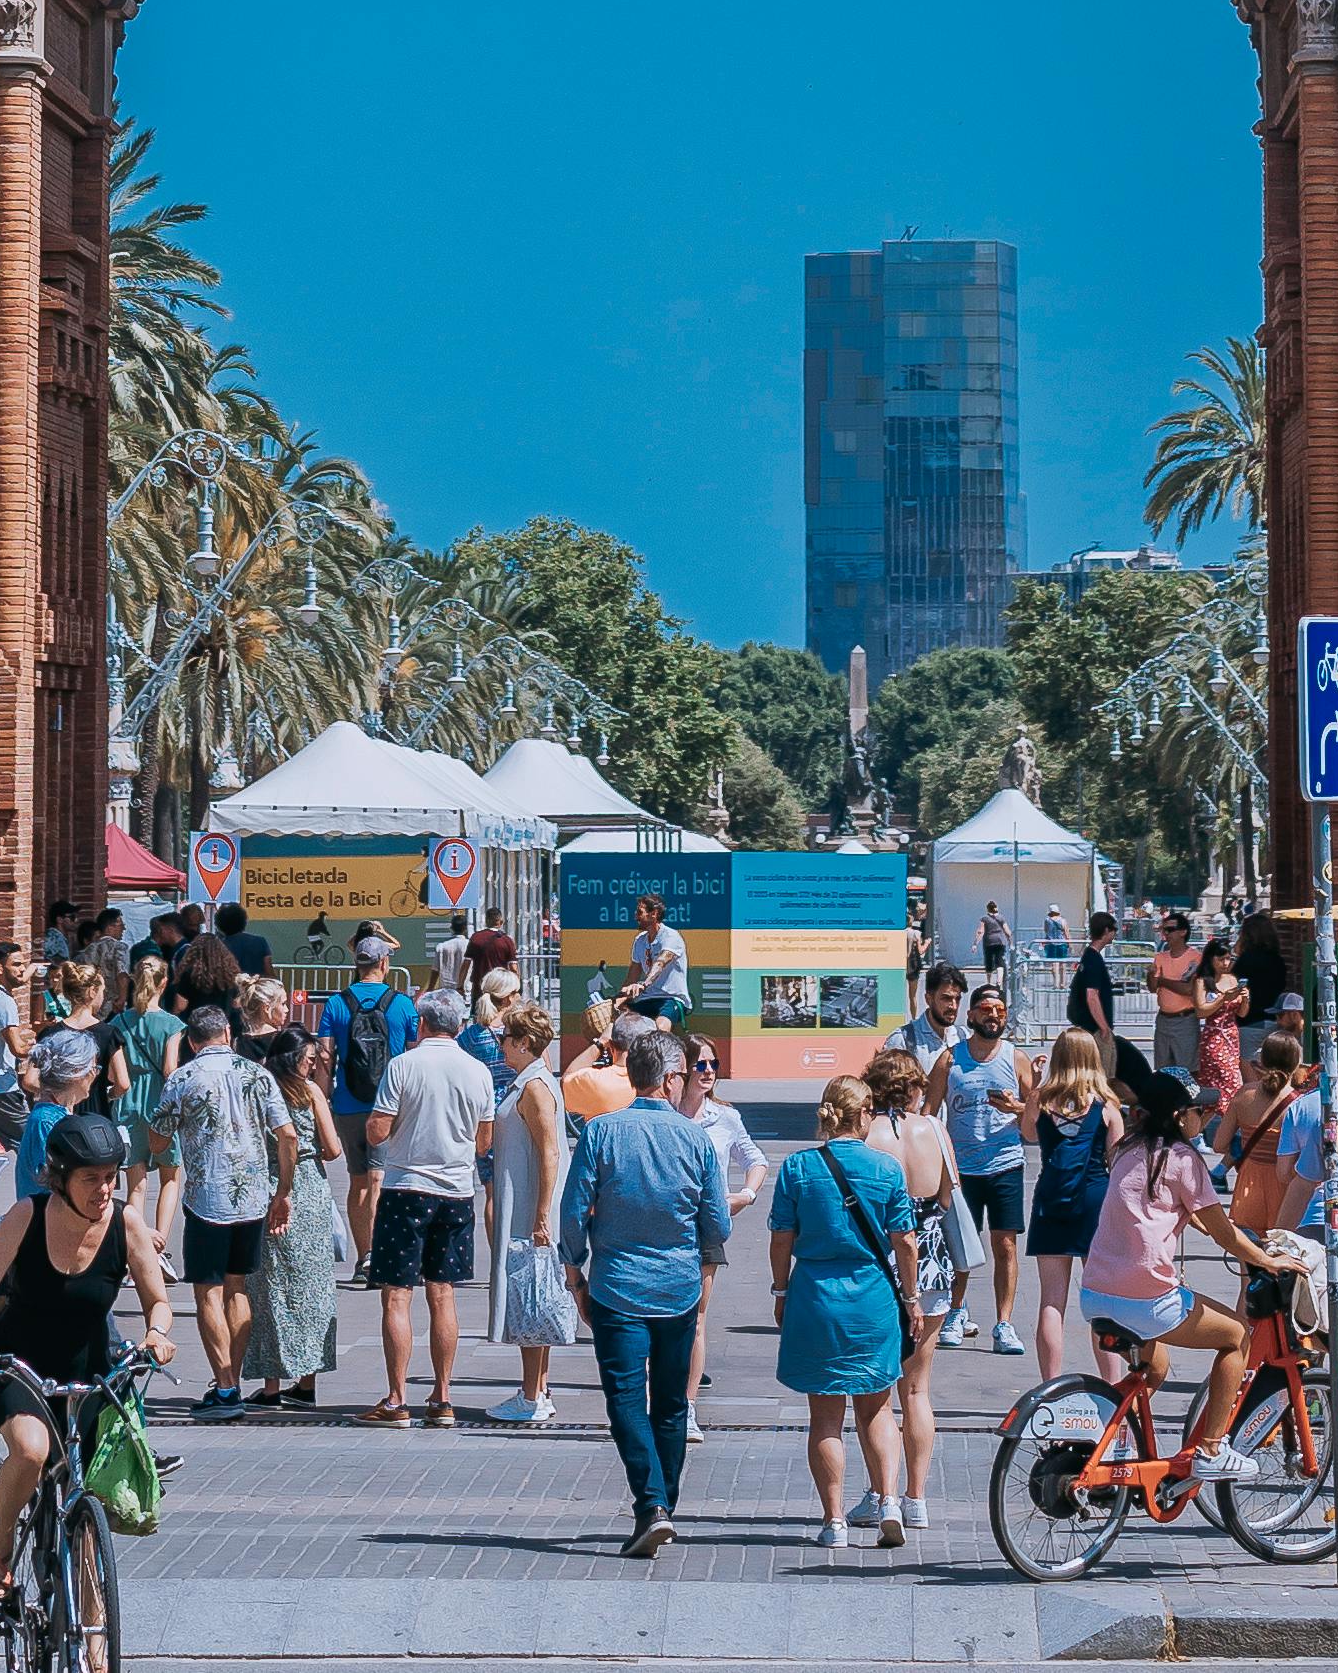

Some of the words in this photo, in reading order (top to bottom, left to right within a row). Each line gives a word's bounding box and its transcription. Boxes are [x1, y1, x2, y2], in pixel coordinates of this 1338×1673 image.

[245, 867, 347, 885] Bicicletada
[568, 874, 603, 895] Fem
[609, 871, 668, 895] créixer
[673, 872, 687, 895] la
[693, 871, 725, 895] bici
[245, 892, 294, 908] Festa
[299, 891, 324, 908] de
[329, 891, 344, 907] la
[349, 890, 382, 907] Bici
[599, 907, 609, 922] a
[614, 899, 629, 922] la
